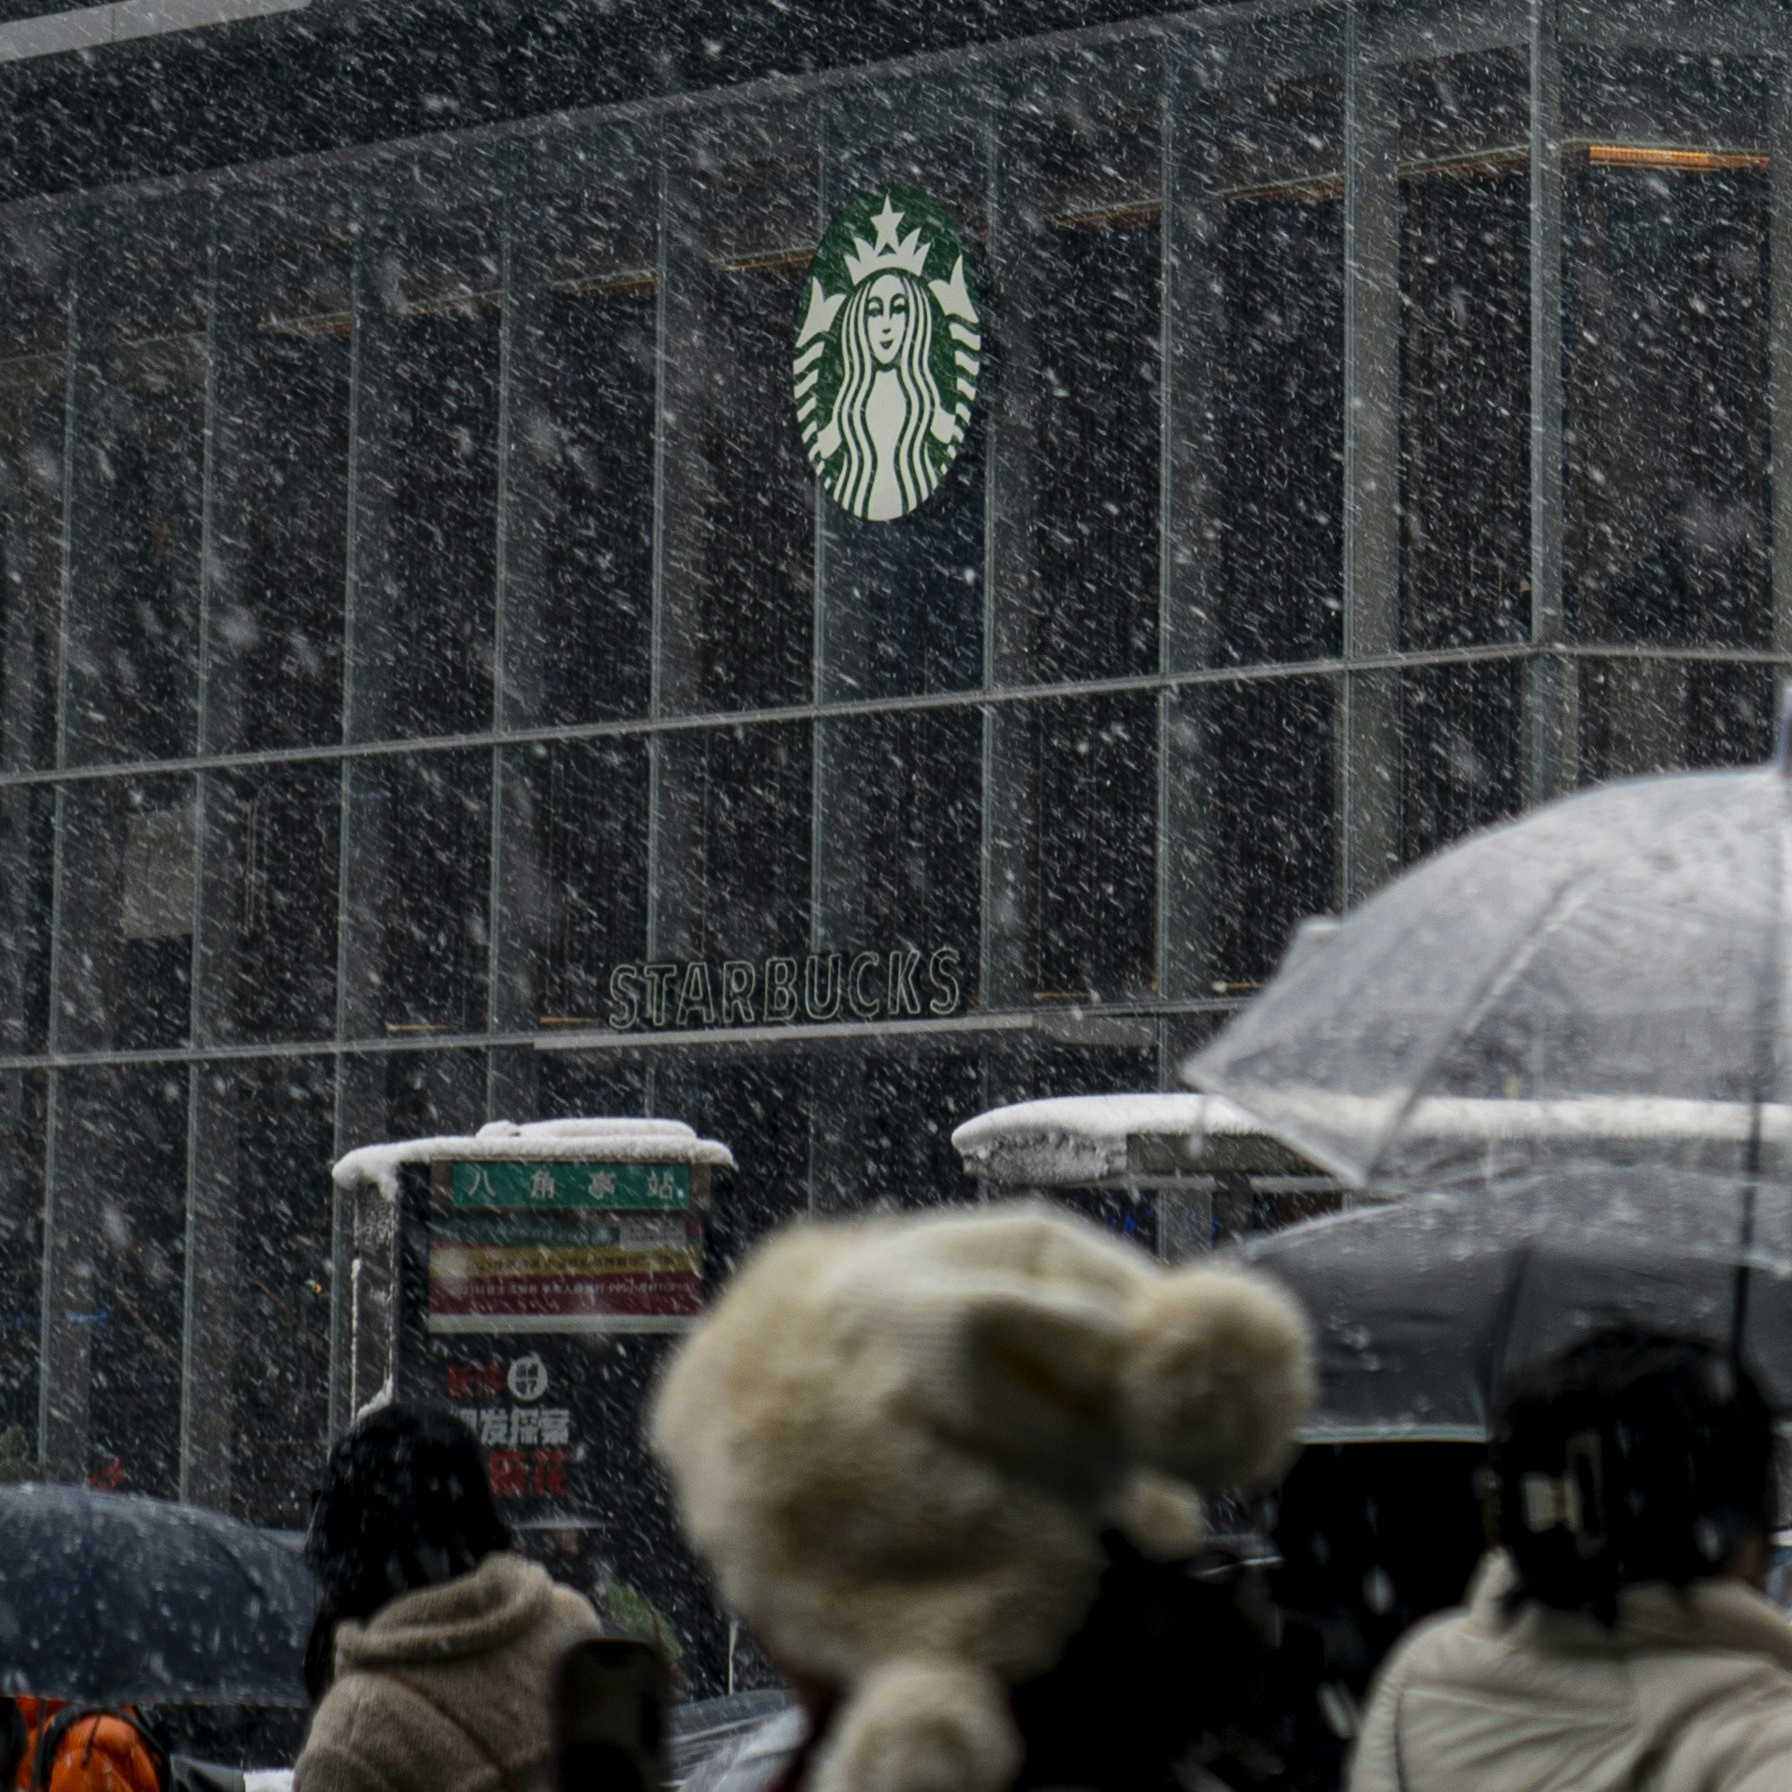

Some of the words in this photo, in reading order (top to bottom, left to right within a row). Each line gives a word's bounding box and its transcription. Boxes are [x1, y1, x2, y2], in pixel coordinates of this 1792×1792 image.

[608, 946, 960, 1030] STARBUCKS
[467, 1169, 675, 1202] 八角亭站
